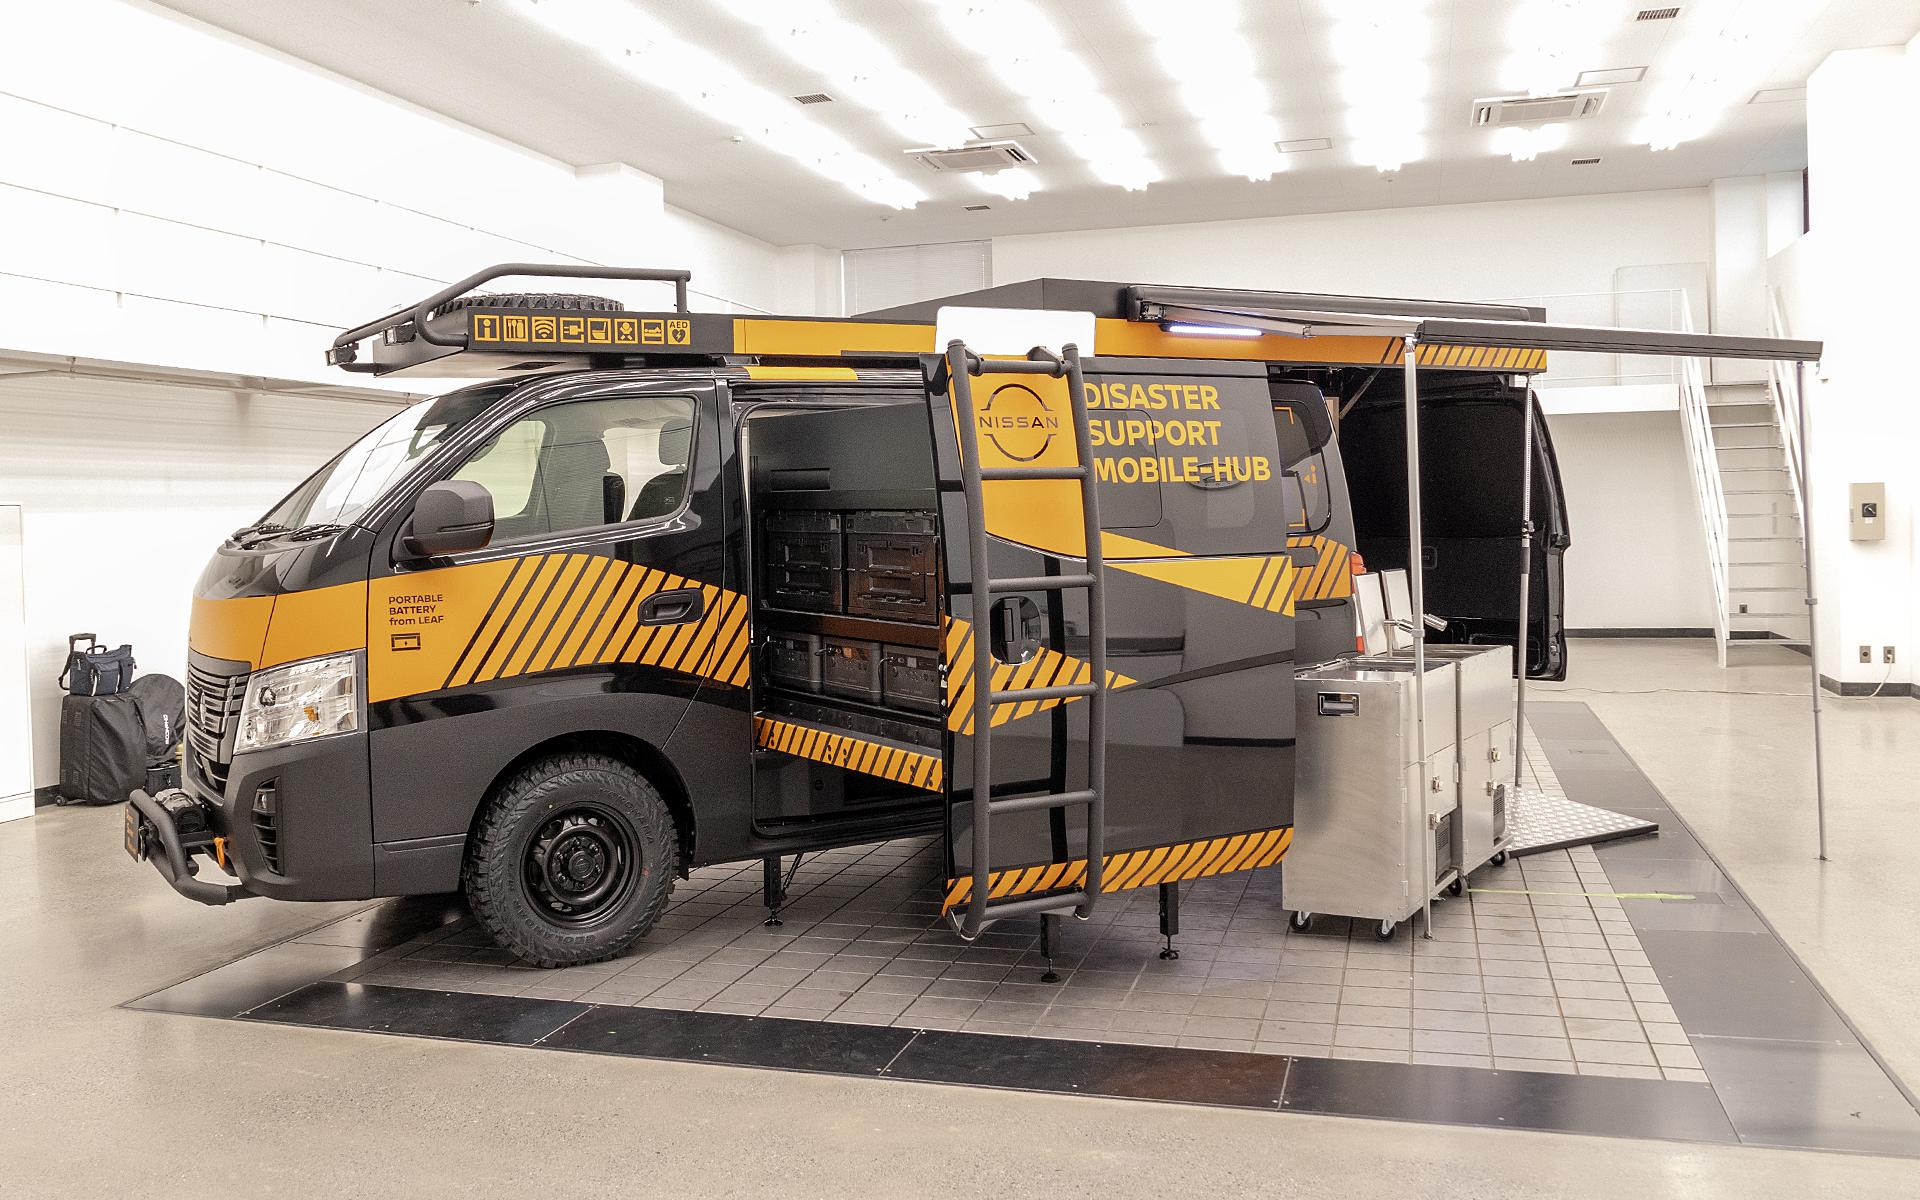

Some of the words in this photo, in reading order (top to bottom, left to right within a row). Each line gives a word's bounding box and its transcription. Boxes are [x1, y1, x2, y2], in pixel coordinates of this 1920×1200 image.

[1083, 382, 1221, 410] DISASTER
[979, 416, 1059, 429] NISSAN
[1088, 419, 1222, 446] SUPPORT
[1093, 456, 1271, 483] MOBILE-HUB
[388, 594, 443, 604] PORTABLE
[389, 605, 436, 615] BATTERY
[389, 617, 416, 626] from
[418, 615, 444, 624] LEAF
